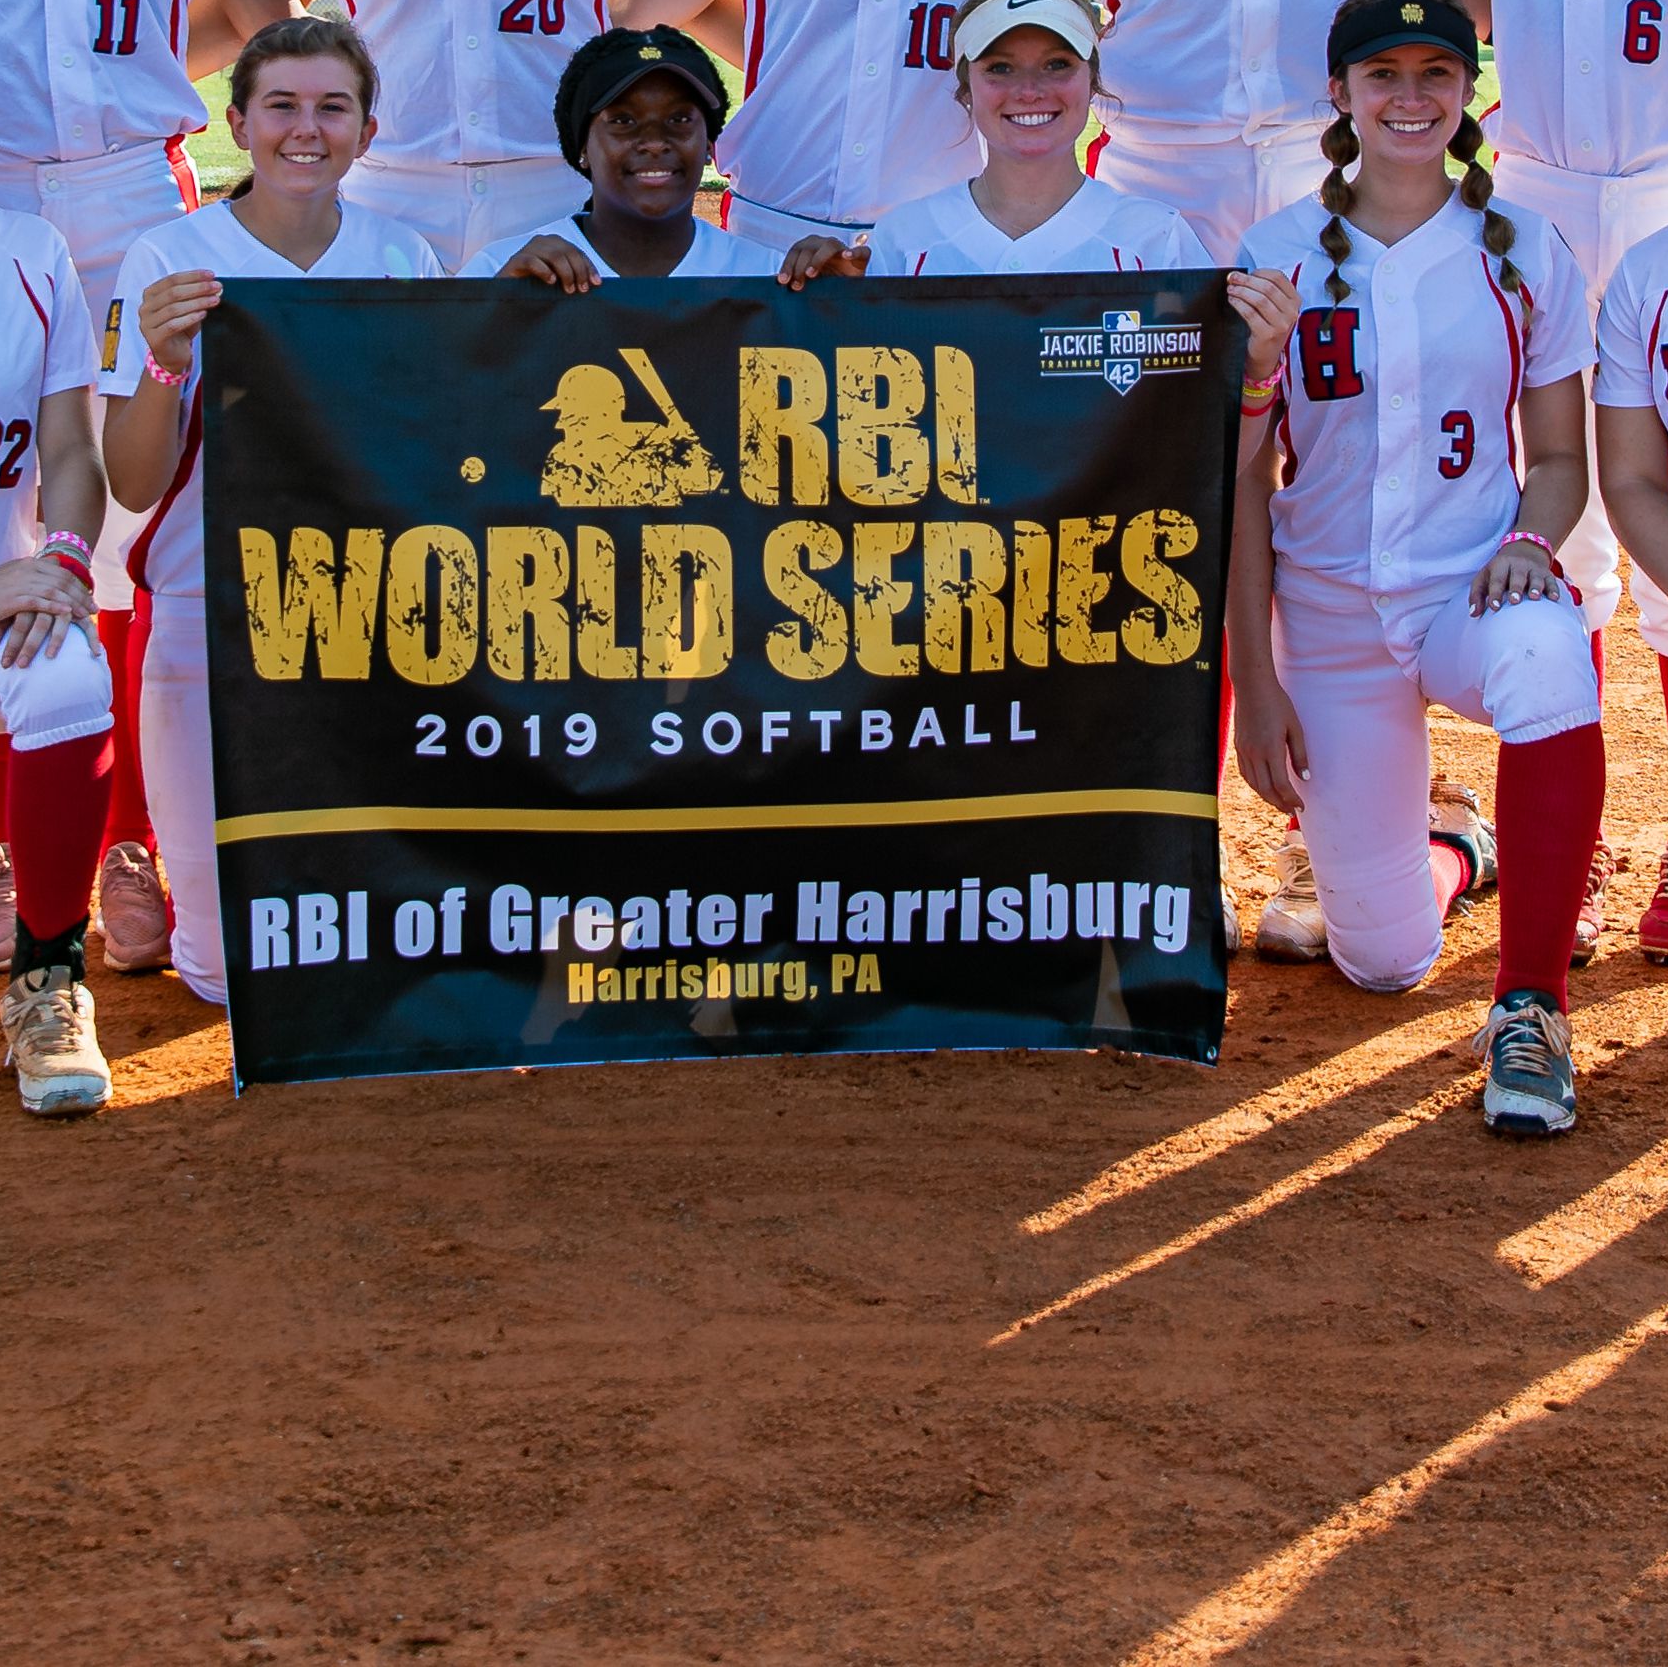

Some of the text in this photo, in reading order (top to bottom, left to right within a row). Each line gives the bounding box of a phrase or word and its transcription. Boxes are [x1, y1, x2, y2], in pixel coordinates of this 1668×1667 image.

[905, 1, 953, 71] 10
[1040, 331, 1202, 356] JACKIE ROBINSON
[1040, 355, 1202, 369] TRAINING COMPLEX
[1109, 363, 1134, 385] 42
[1297, 307, 1364, 402] H
[738, 345, 978, 507] RBI
[1437, 410, 1476, 479] 3
[238, 508, 1202, 684] WORLD SERIES
[414, 700, 1038, 757] 2019 SOFTBALL
[250, 873, 1191, 970] RBI of Greater Harrisburg
[566, 953, 882, 1005] Harrisburg, PA
